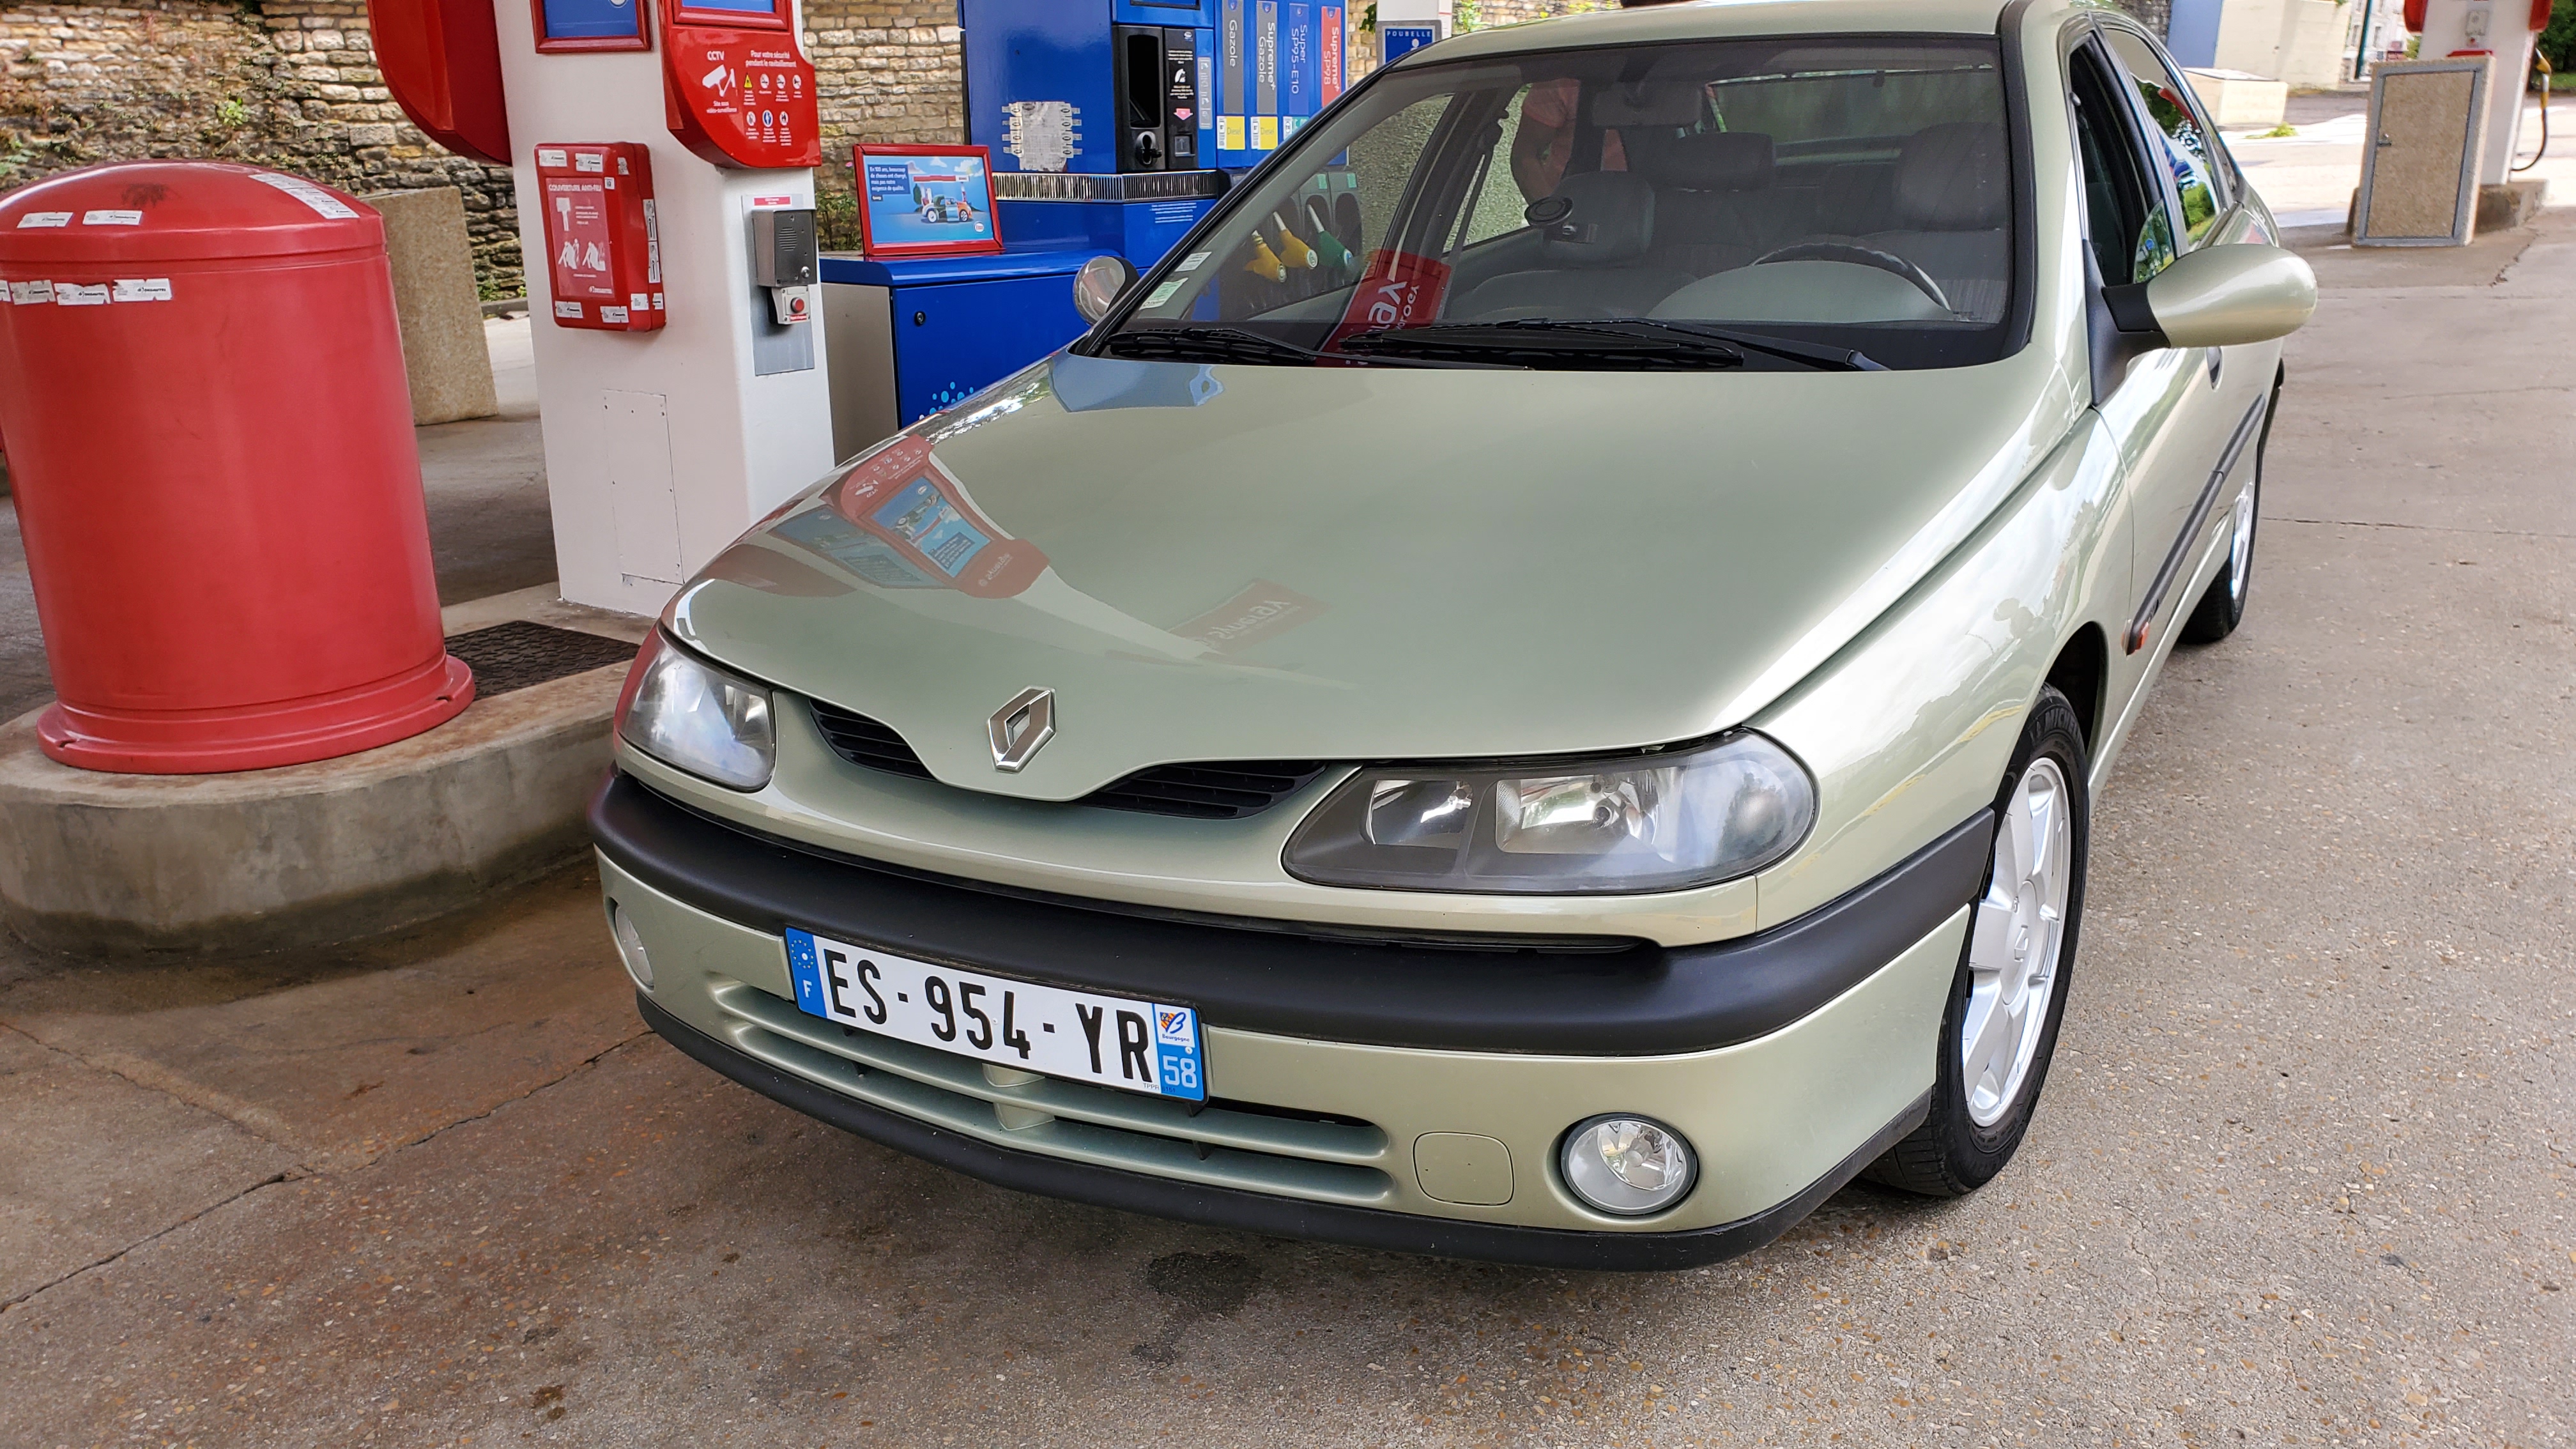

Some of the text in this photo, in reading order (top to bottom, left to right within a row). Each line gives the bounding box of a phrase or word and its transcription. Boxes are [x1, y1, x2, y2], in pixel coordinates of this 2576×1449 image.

[707, 50, 724, 60] CCTV
[1229, 20, 1238, 66] Gazole
[1298, 25, 1307, 63] Super
[802, 979, 813, 998] F
[1162, 1033, 1190, 1042] Bourgogne
[1163, 1055, 1197, 1088] 58
